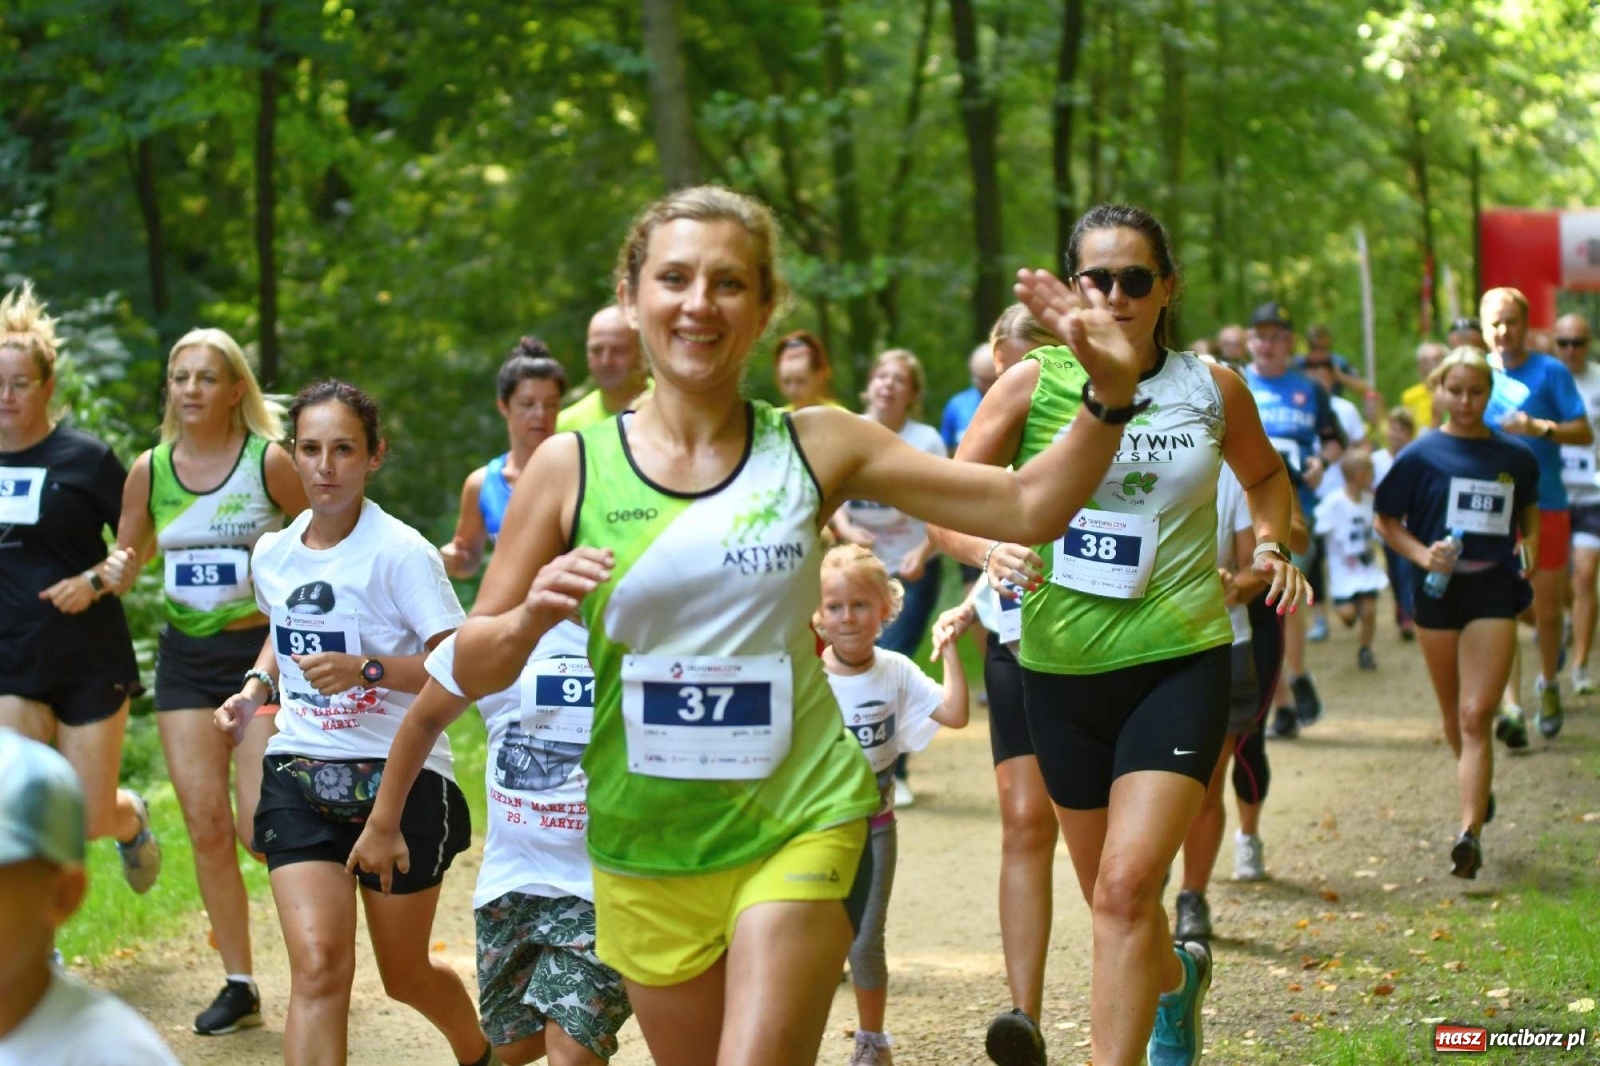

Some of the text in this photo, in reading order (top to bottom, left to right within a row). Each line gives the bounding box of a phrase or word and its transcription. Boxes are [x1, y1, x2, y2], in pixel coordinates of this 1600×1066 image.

[1118, 433, 1195, 451] YWNI
[1114, 450, 1173, 462] YSKI
[1471, 494, 1493, 511] 88
[606, 508, 658, 524] deep
[1080, 533, 1117, 560] 38
[191, 564, 219, 585] 35
[289, 631, 323, 655] 93
[562, 678, 596, 704] 91
[677, 686, 735, 722] 37
[858, 722, 887, 747] 94
[540, 815, 585, 831] MARYL
